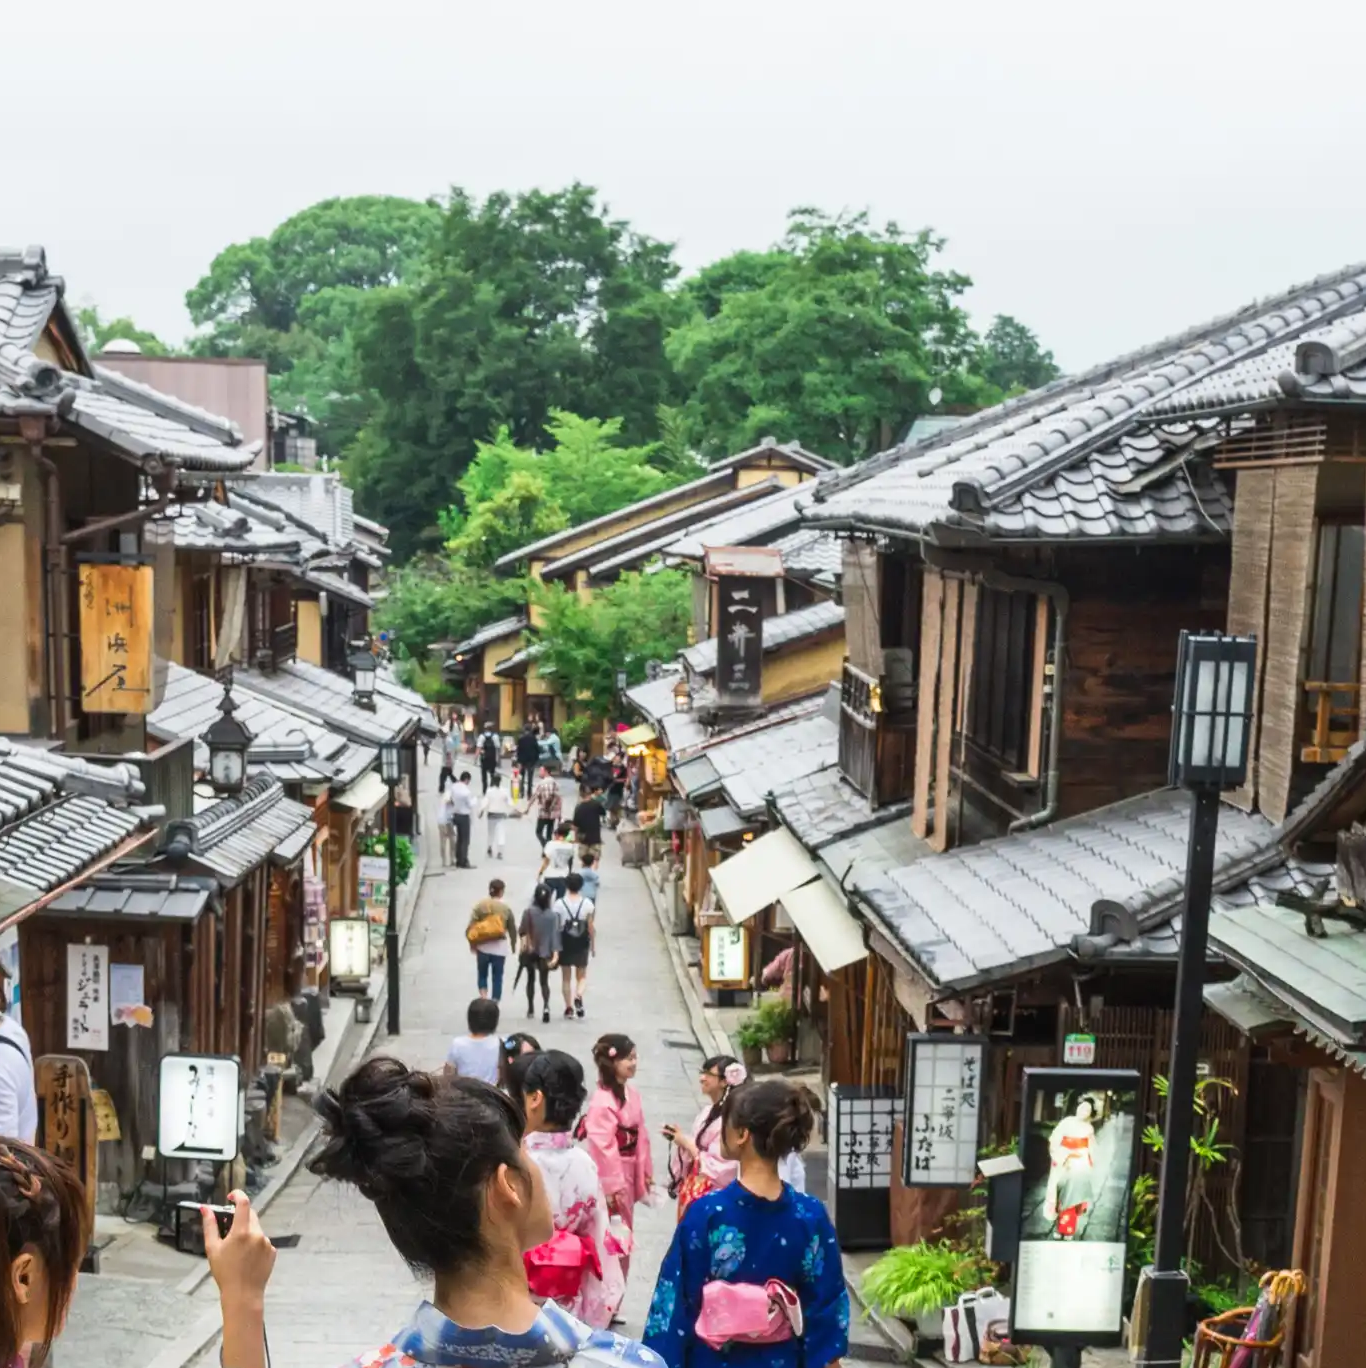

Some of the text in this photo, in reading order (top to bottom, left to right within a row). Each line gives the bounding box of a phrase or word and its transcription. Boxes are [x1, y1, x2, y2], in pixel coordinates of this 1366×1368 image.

[959, 1056, 976, 1109] そば処
[915, 1113, 937, 1171] ふたば
